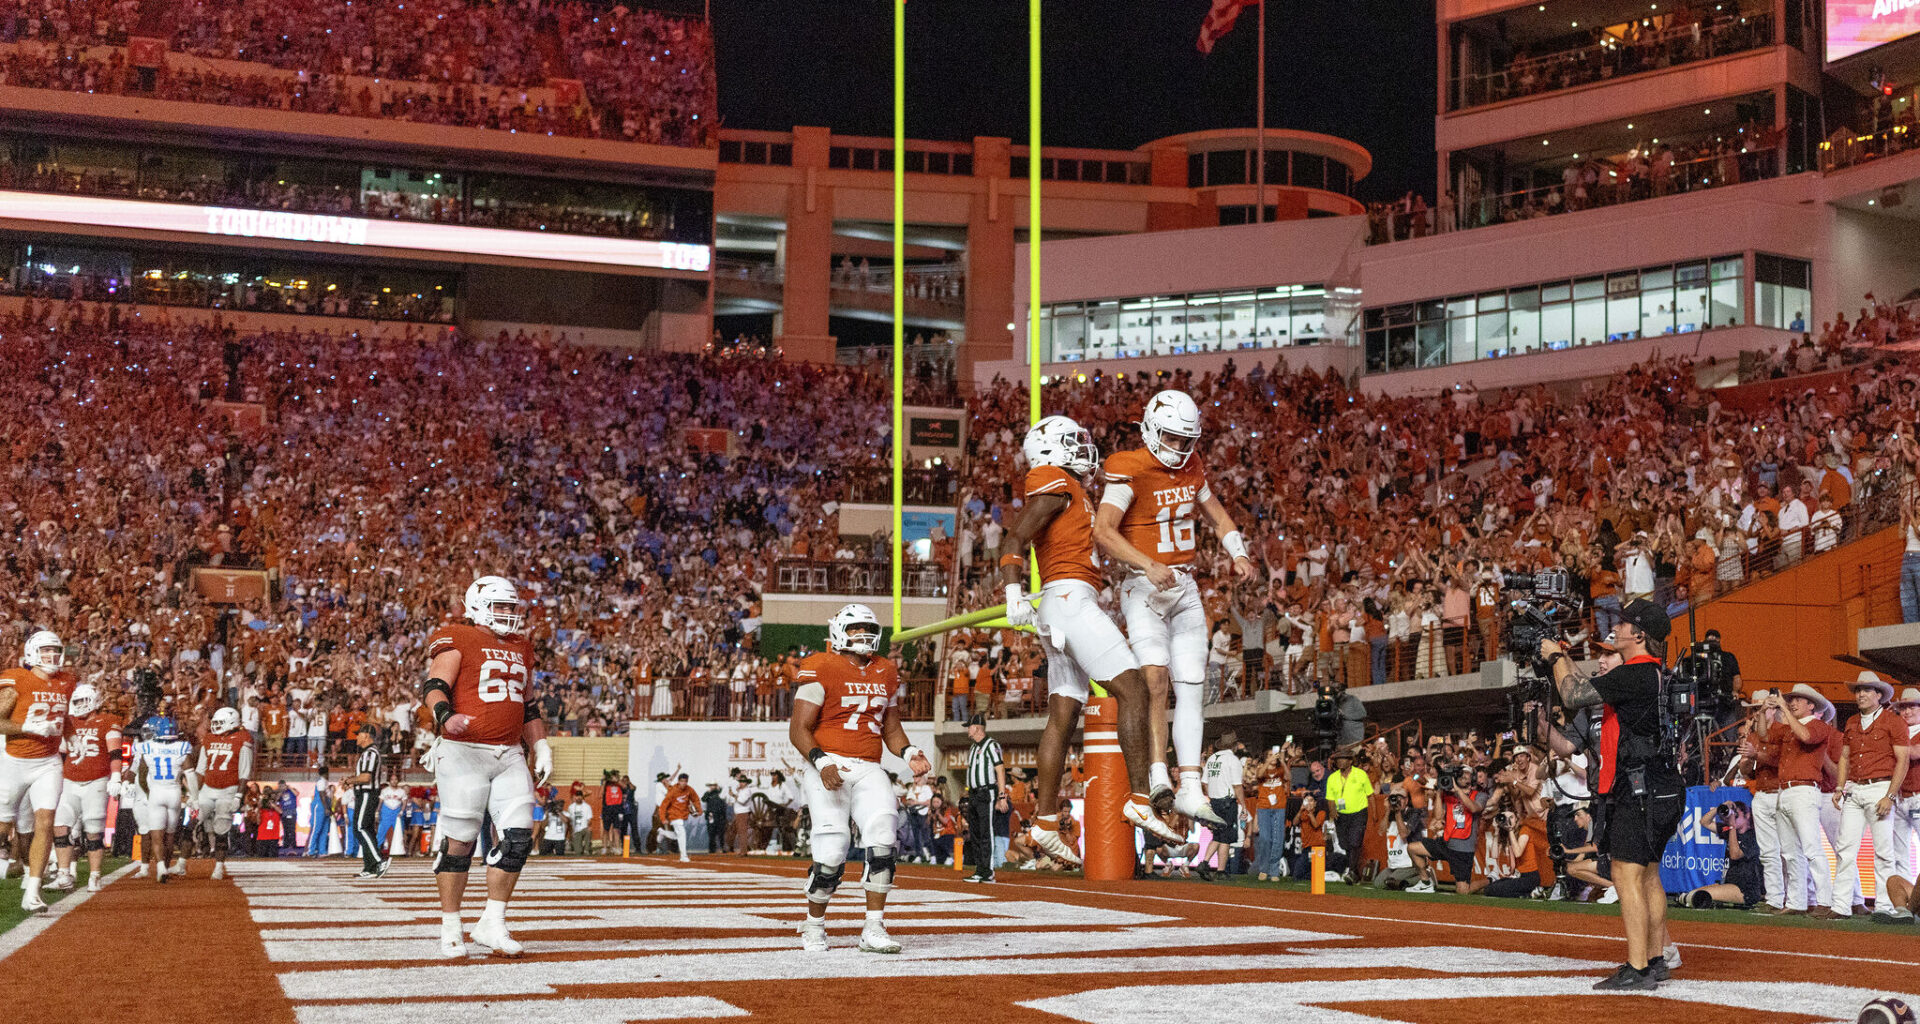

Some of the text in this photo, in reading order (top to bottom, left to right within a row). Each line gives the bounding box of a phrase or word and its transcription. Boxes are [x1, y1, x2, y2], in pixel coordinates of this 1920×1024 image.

[204, 206, 368, 245] TOUCHDOWN
[1153, 485, 1196, 506] TEXAS
[1156, 503, 1196, 554] 16
[481, 648, 525, 665] TEXAS
[478, 659, 528, 703] 62
[844, 681, 888, 696] TEXAS
[32, 691, 68, 705] TEXAS
[841, 695, 888, 735] 73
[75, 727, 99, 737] EXAS
[210, 742, 233, 750] TEXAS
[153, 756, 175, 780] 11
[207, 750, 234, 771] 77
[1010, 751, 1037, 766] THE
[1676, 806, 1725, 845] ELL
